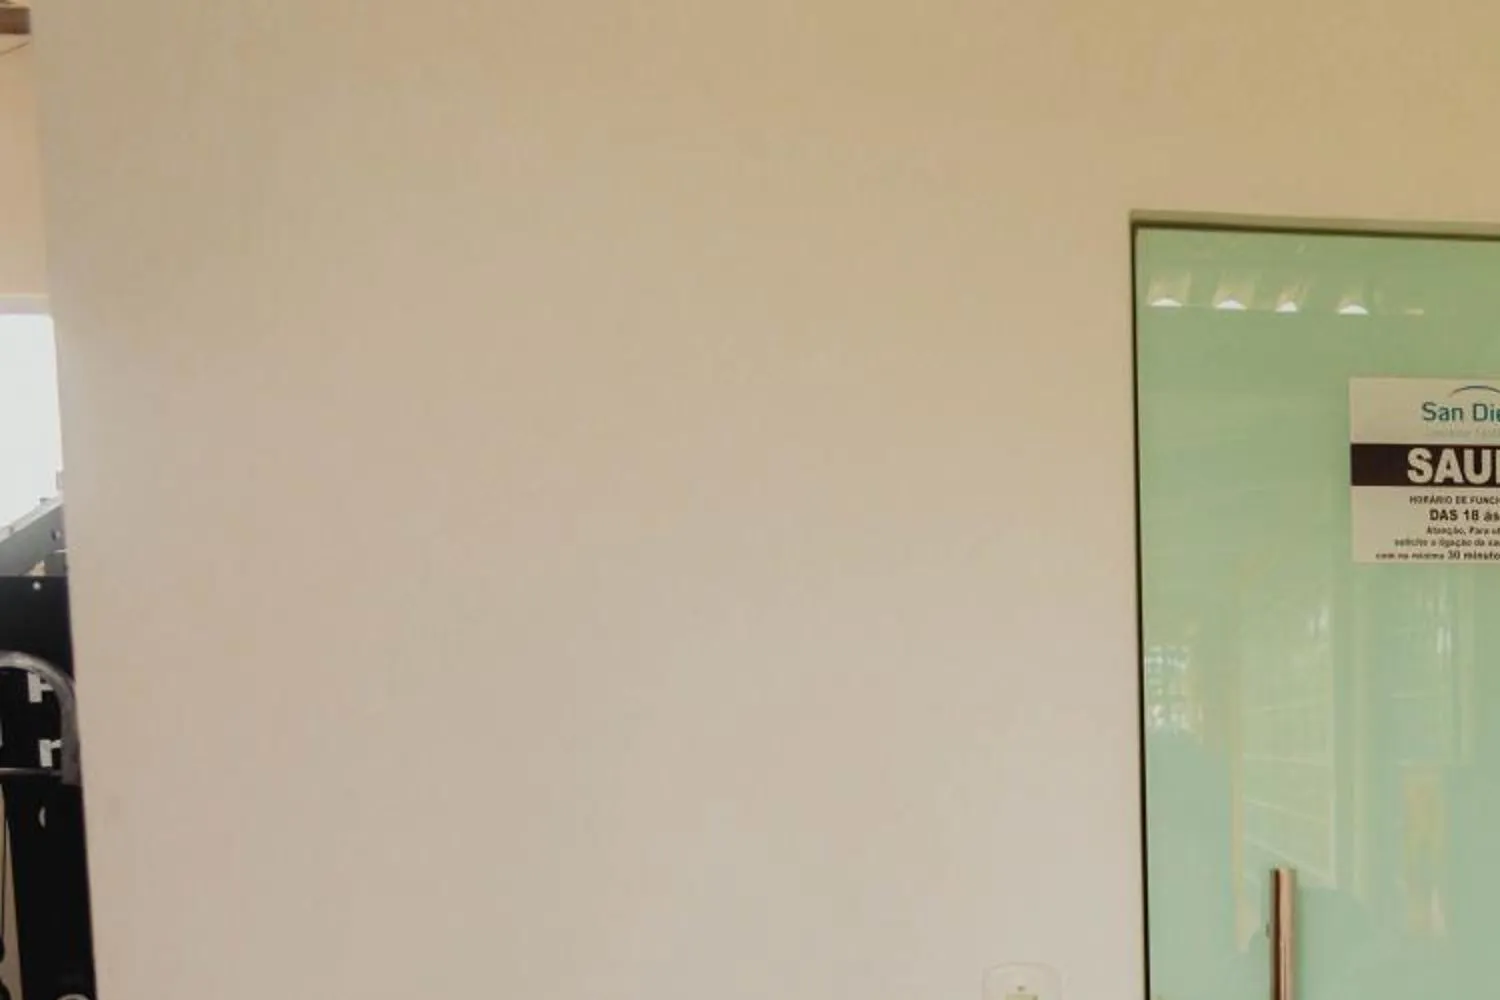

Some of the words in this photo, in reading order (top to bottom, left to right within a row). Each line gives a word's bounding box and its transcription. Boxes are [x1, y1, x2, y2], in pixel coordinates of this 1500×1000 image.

[1421, 401, 1463, 421] San
[1455, 495, 1468, 505] DE
[1429, 508, 1458, 521] DAS
[1463, 508, 1479, 521] 18
